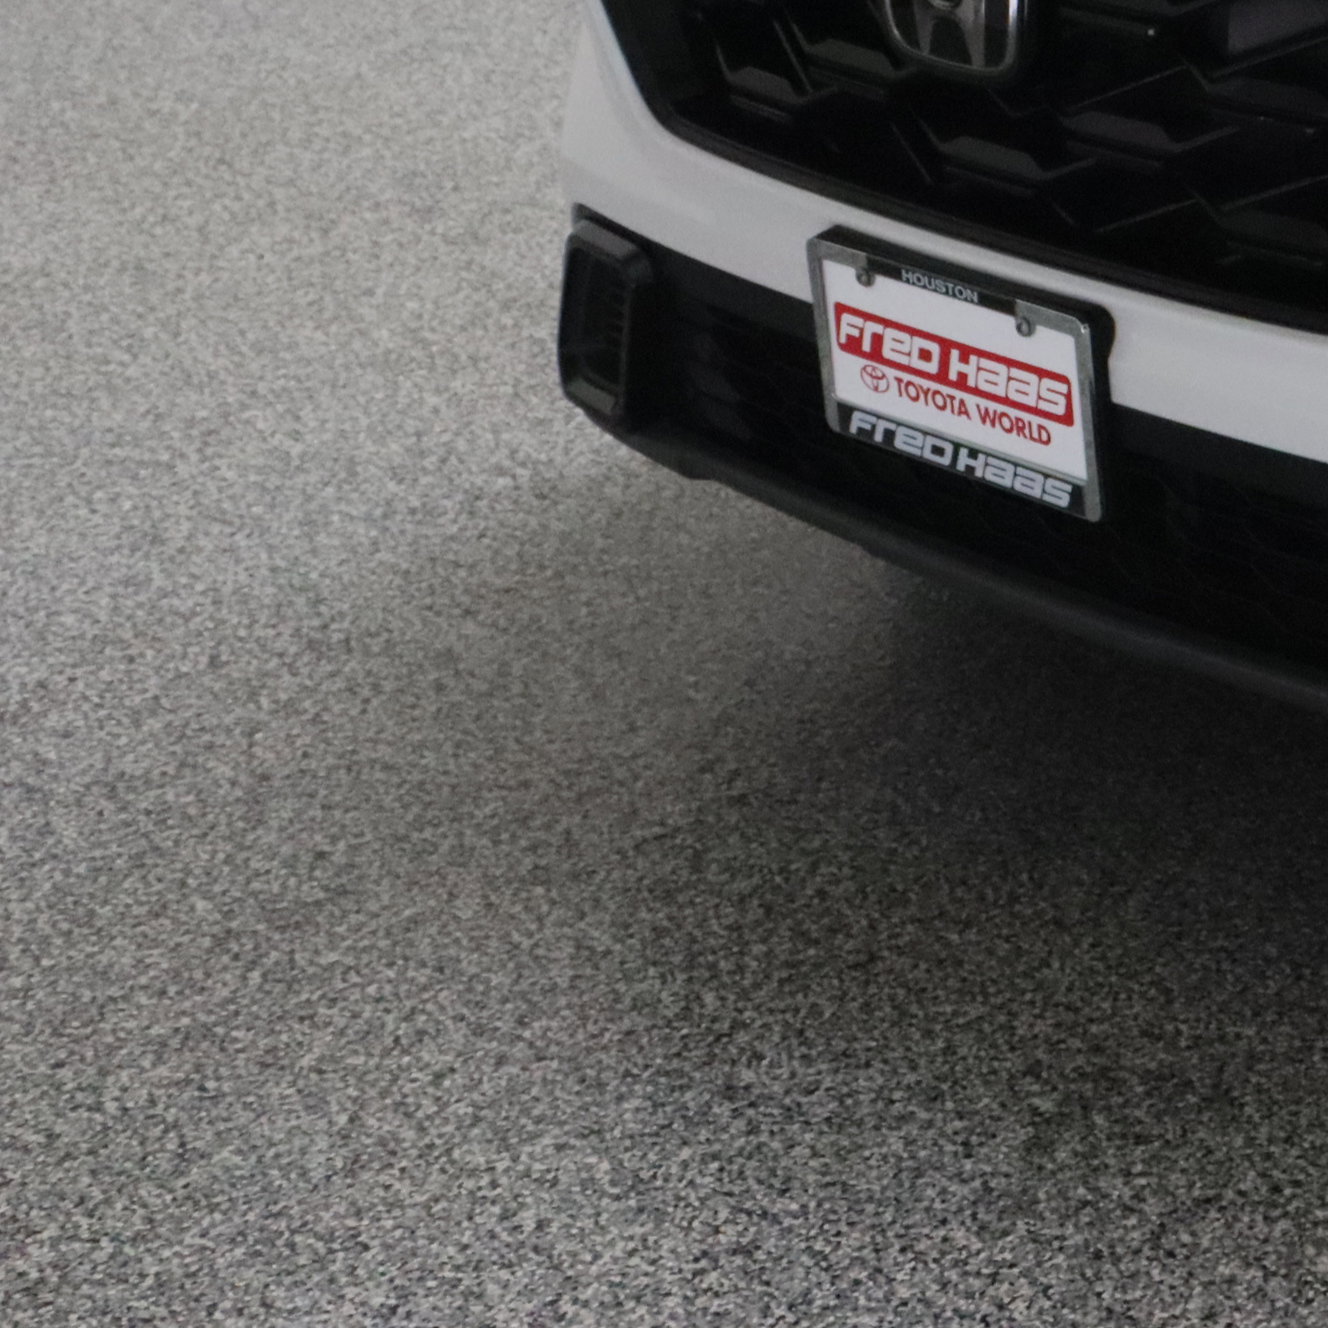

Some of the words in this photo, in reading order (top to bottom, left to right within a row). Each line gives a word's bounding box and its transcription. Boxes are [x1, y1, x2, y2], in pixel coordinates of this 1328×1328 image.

[901, 269, 979, 303] HOUSTON
[894, 376, 972, 421] TOYOTA
[975, 404, 1052, 446] WORLD
